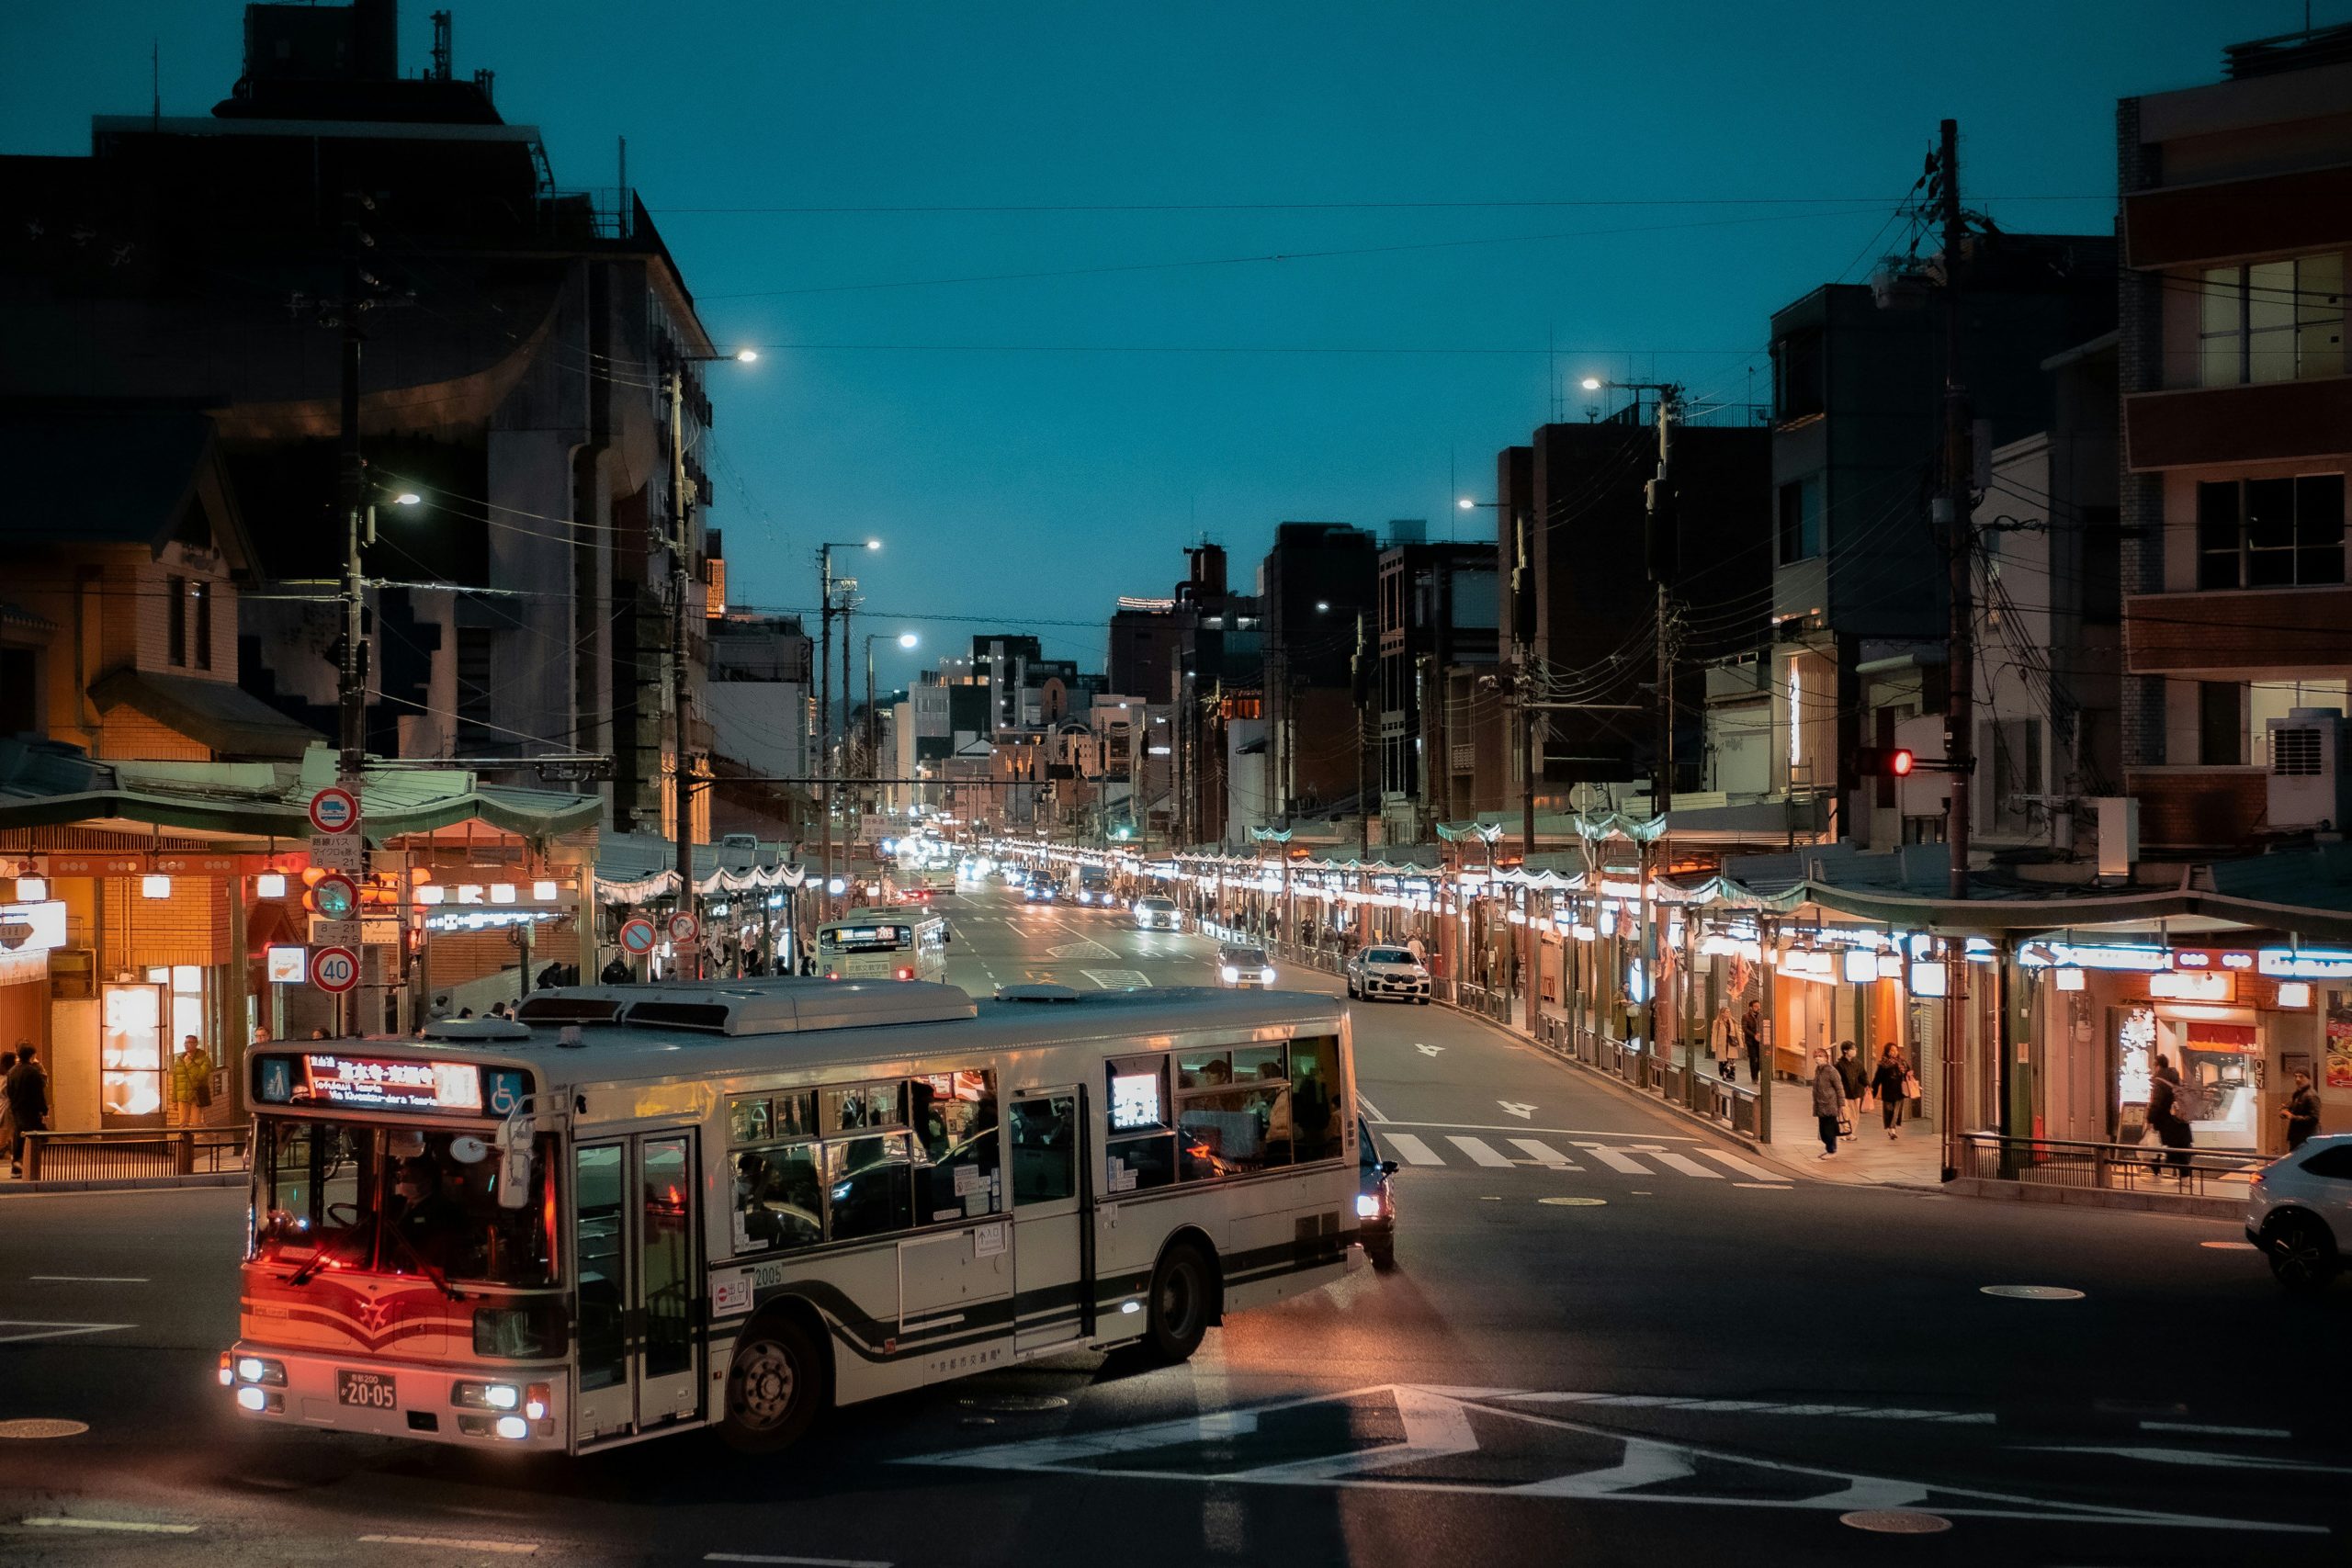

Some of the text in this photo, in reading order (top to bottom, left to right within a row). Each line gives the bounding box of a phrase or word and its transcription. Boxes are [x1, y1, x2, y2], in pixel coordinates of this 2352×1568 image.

[312, 837, 349, 847] 路線バス
[316, 934, 361, 943] ここから
[877, 928, 894, 940] 203
[322, 960, 349, 980] 40
[755, 1264, 782, 1286] 2005
[728, 1280, 745, 1295] 出口
[348, 1382, 393, 1407] 20-05
